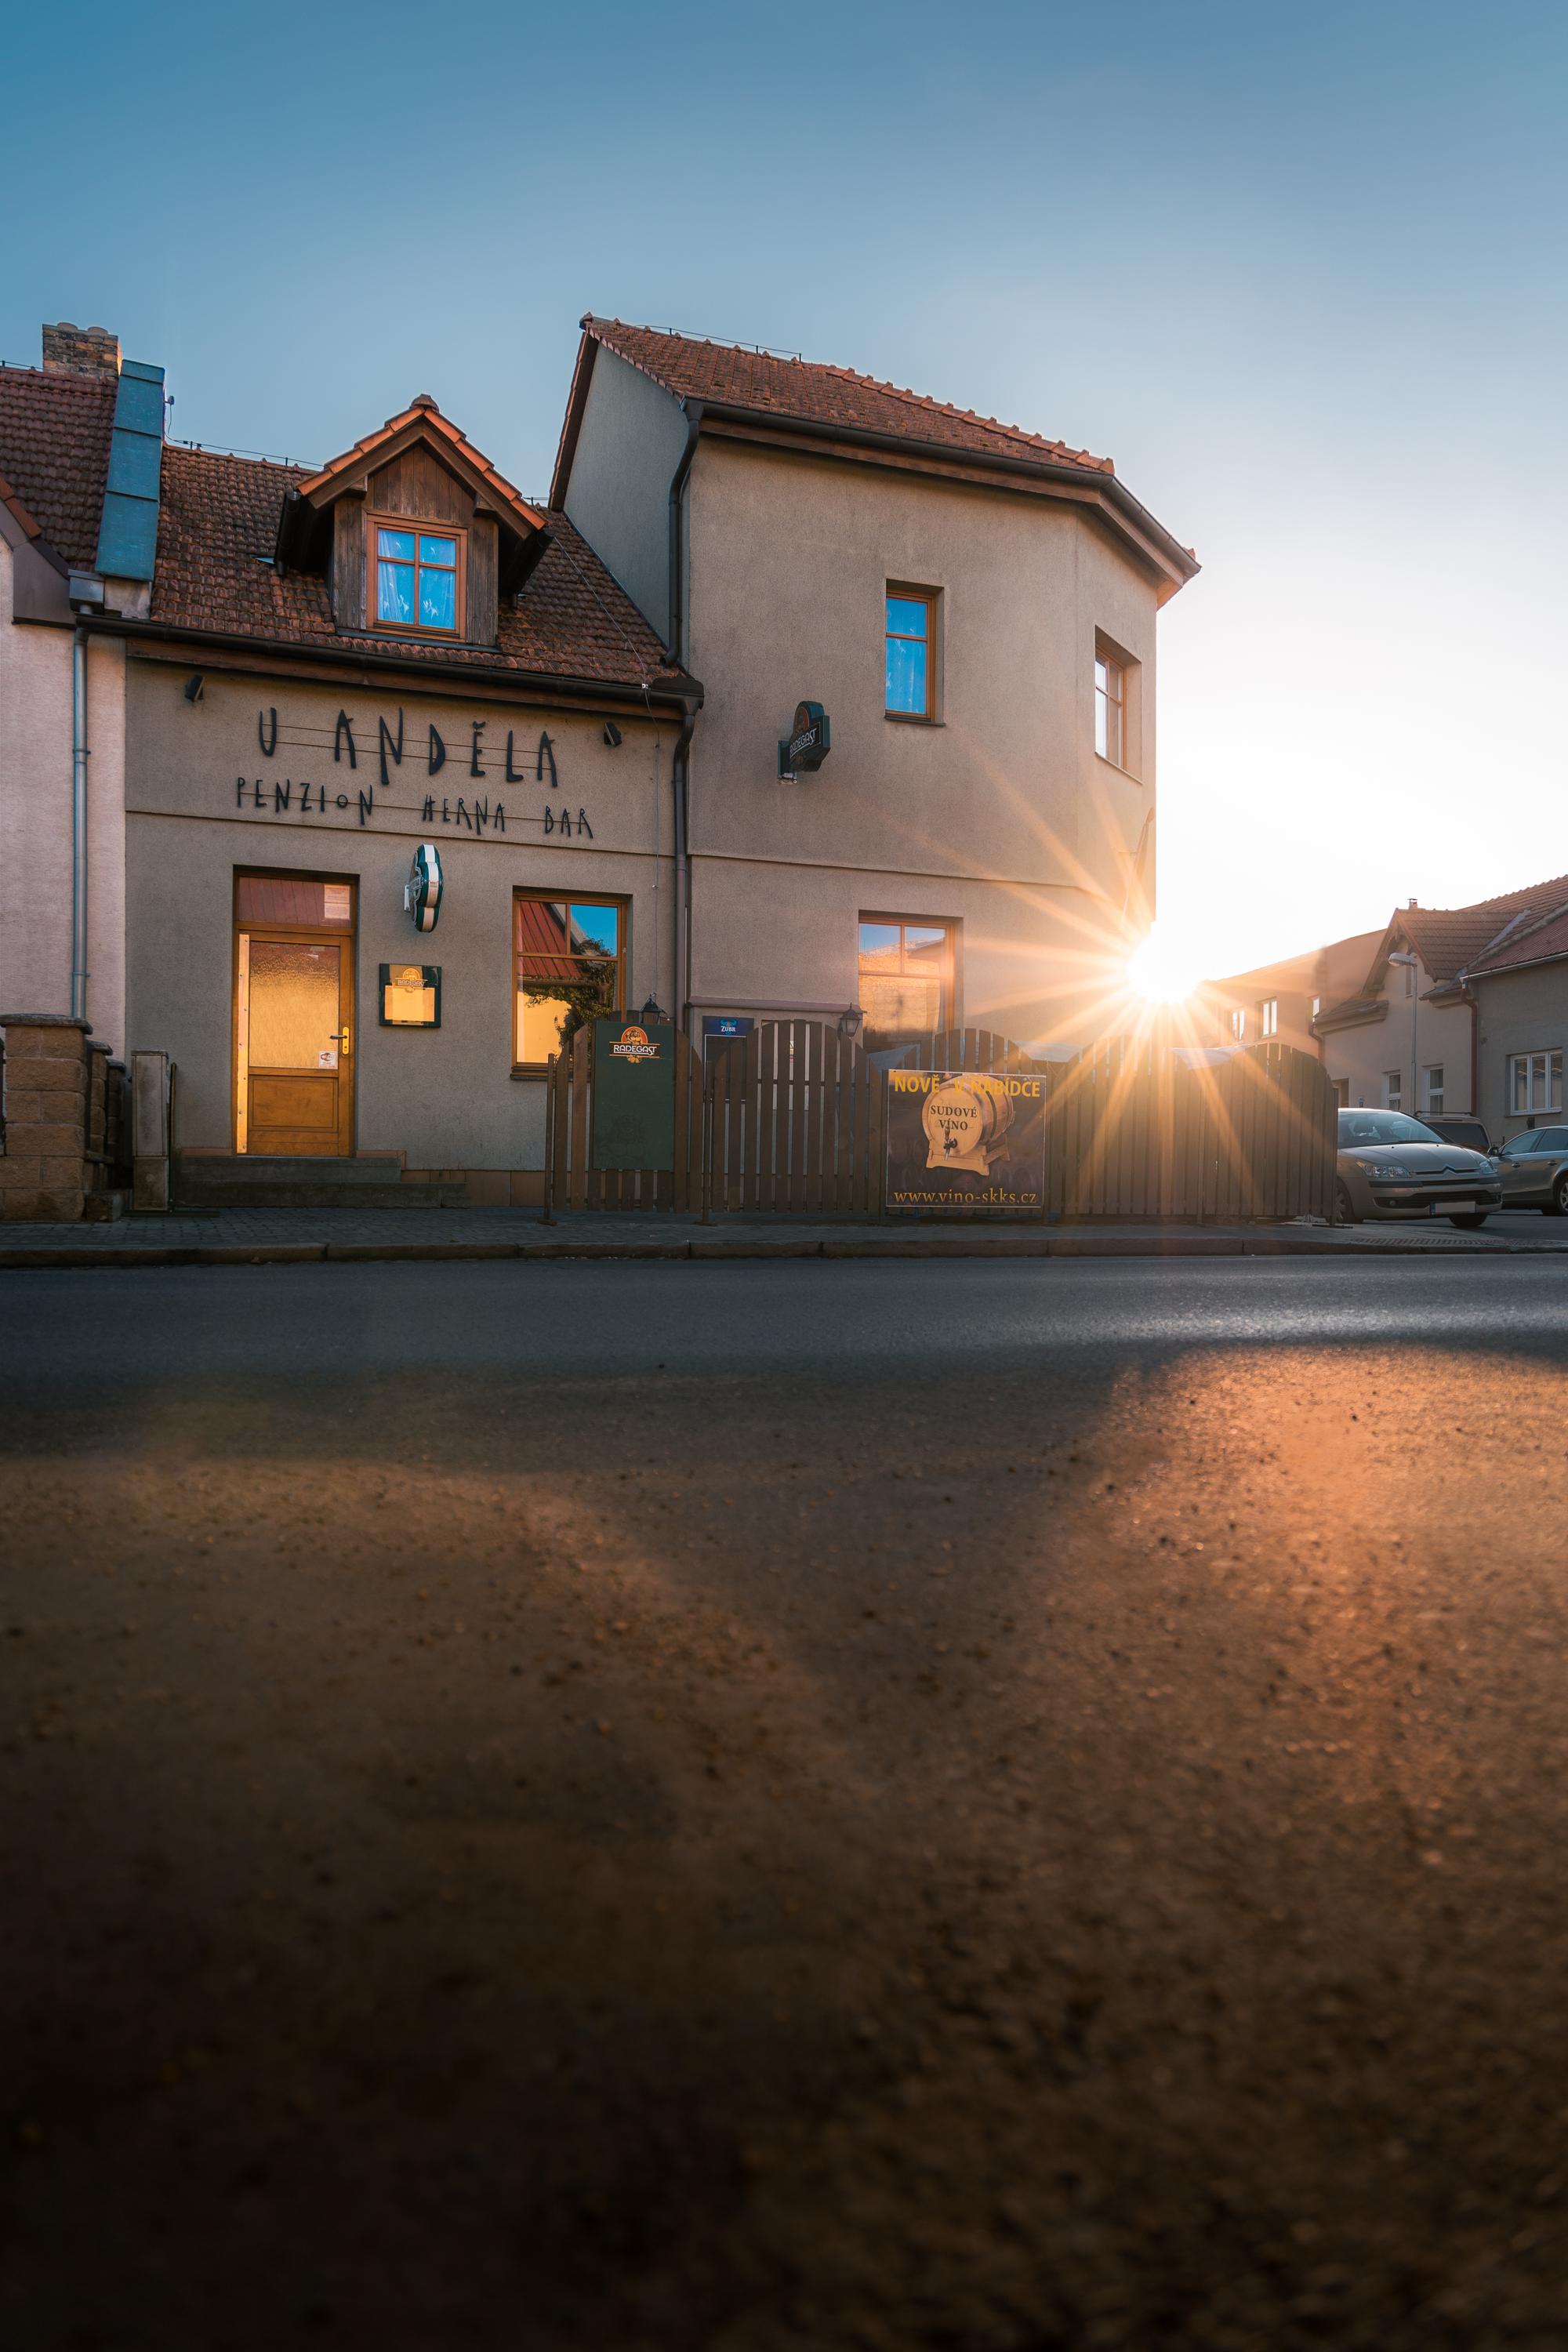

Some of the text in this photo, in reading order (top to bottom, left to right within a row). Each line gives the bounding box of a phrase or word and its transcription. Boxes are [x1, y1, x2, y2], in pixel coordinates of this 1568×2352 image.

[260, 706, 558, 787] U ANDĚLA
[237, 777, 594, 839] PENZION HERNA BAR
[613, 1044, 657, 1056] RADEGAST
[894, 1074, 1040, 1097] NOVĚ V NABÍDCE
[930, 1105, 978, 1119] SUDOVÉ
[938, 1118, 968, 1131] VÍNO
[894, 1188, 1036, 1203] www.vino-skks.cz
